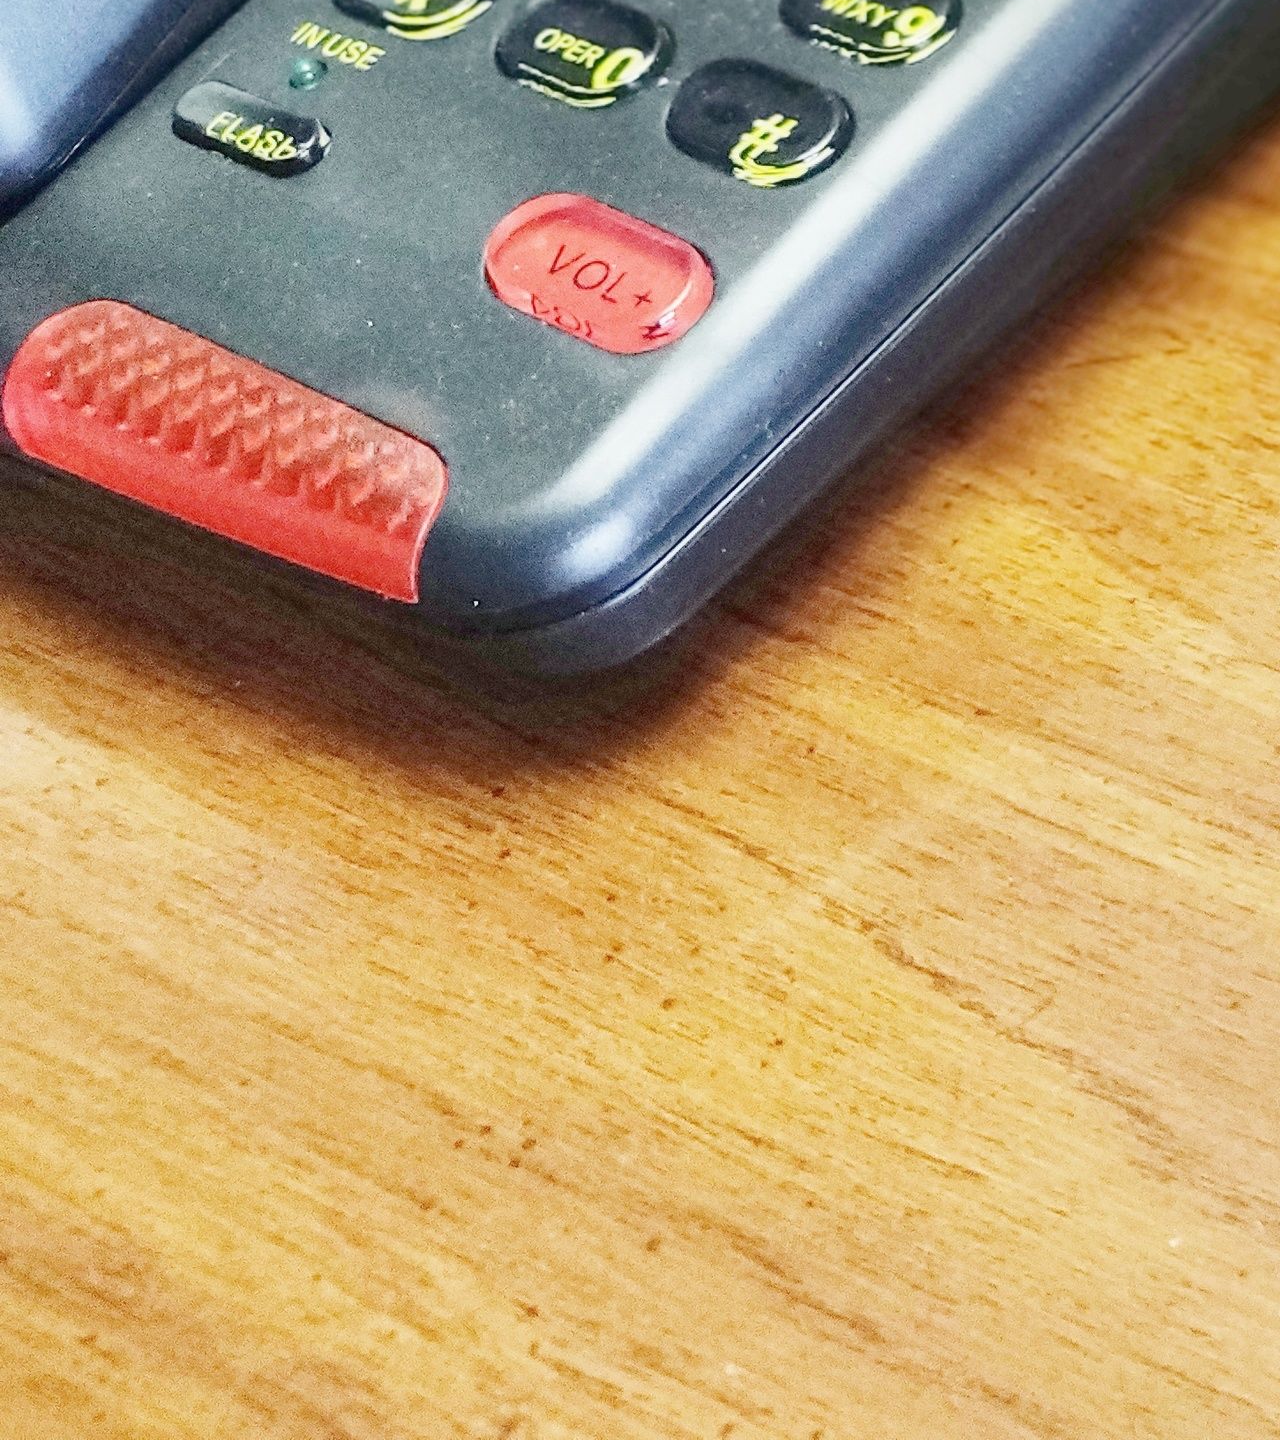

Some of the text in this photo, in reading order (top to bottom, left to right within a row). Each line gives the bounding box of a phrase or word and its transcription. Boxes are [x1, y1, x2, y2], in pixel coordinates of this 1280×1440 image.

[290, 21, 387, 71] IN USE
[883, 5, 938, 48] 9
[533, 27, 647, 91] OPER 0
